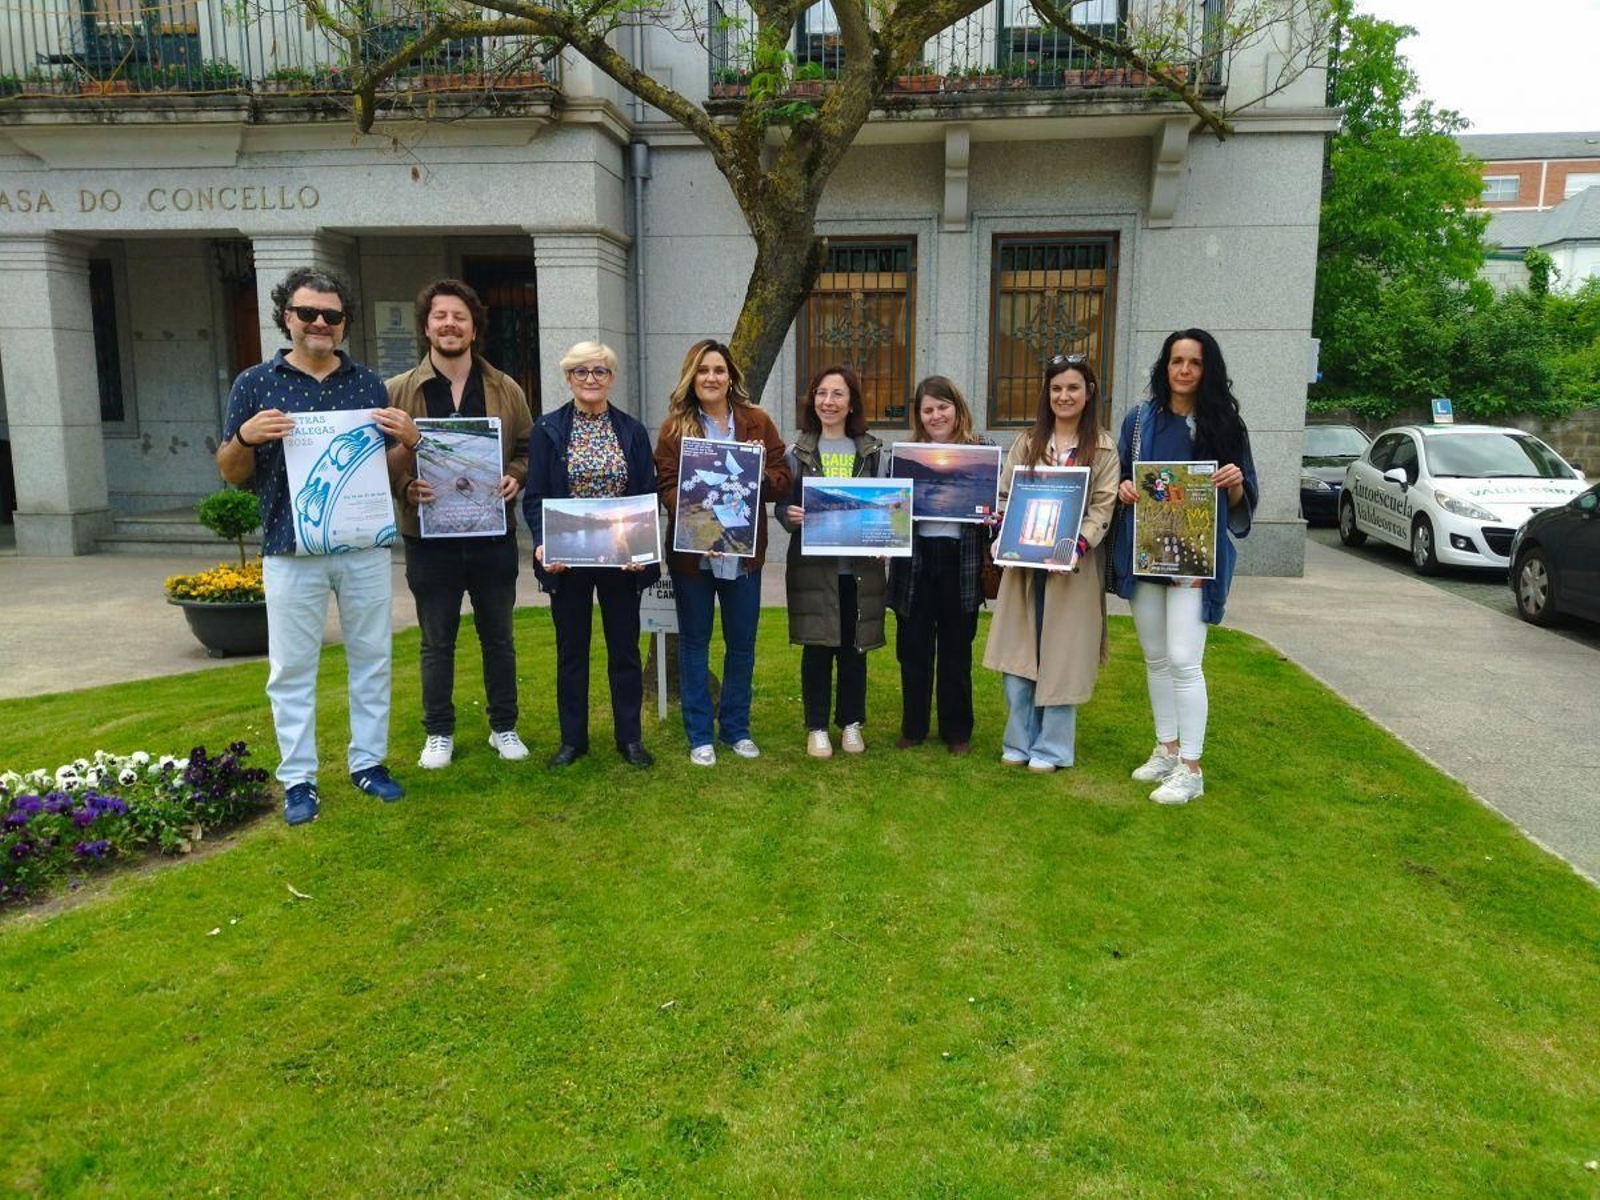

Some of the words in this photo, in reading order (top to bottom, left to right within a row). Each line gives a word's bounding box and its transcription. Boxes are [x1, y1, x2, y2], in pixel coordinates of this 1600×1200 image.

[0, 189, 55, 213] ASA
[79, 189, 122, 212] DO
[147, 185, 320, 212] CONCELLO
[1351, 480, 1413, 520] Autoescuela
[1466, 486, 1580, 497] VALDEORRA
[1356, 501, 1407, 540] Valdeorras
